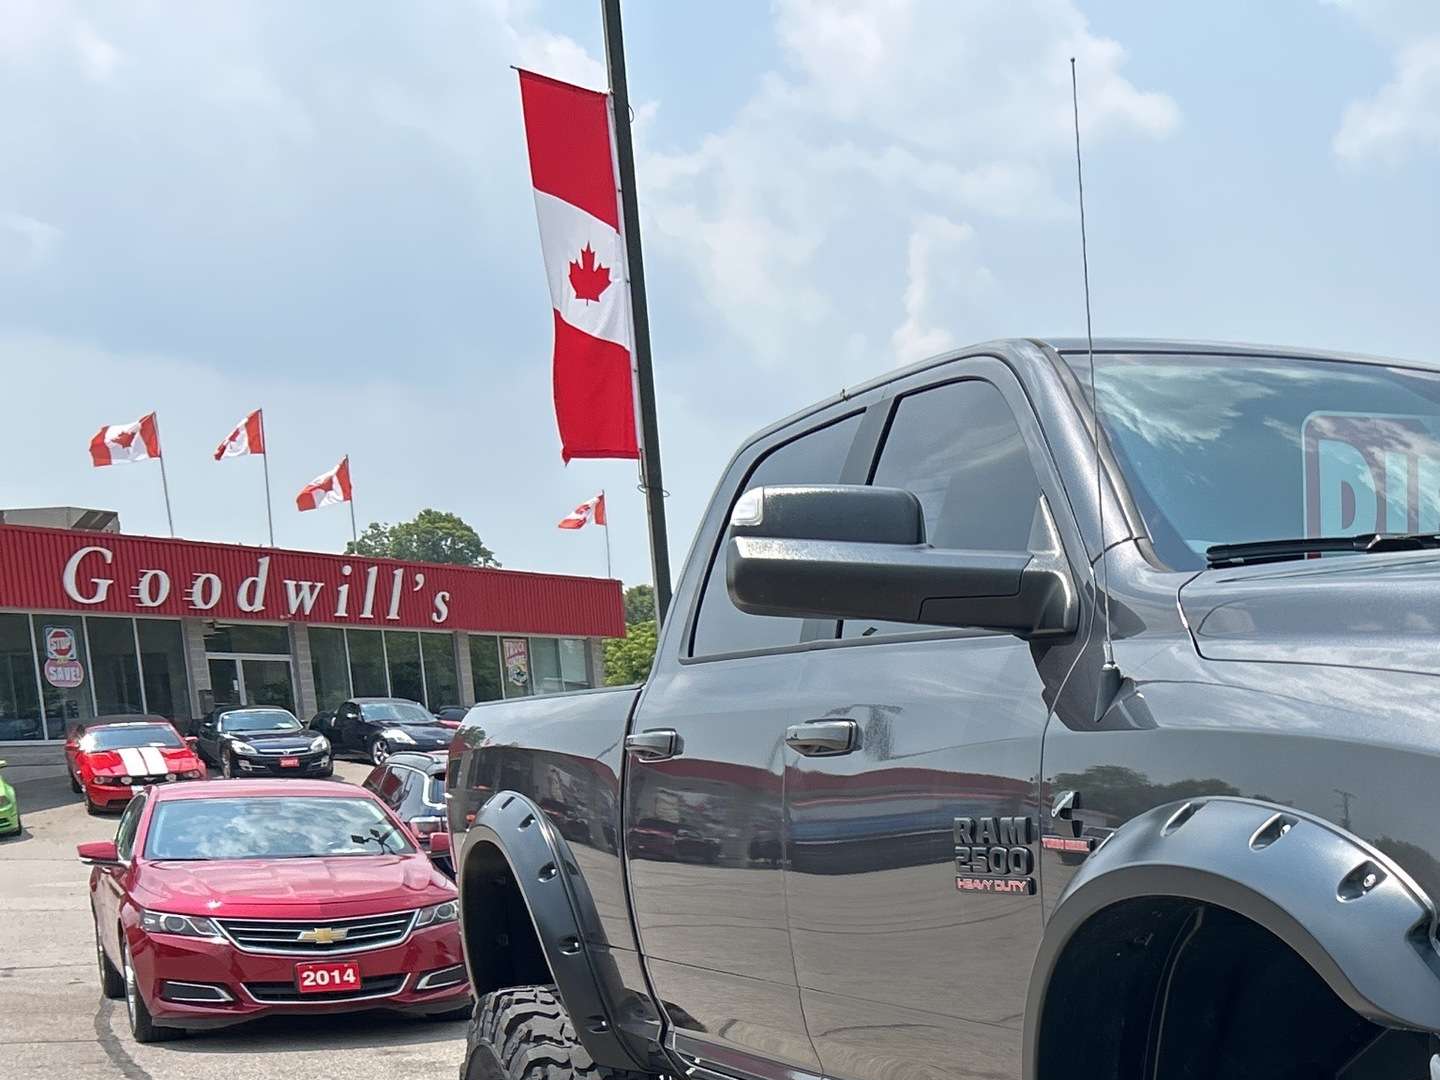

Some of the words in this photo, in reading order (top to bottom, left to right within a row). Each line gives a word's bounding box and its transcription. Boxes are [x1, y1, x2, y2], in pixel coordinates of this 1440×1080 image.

[62, 545, 451, 624] Goodwill's
[48, 666, 81, 681] SAVE!
[954, 816, 1032, 845] RAM
[954, 845, 1034, 875] 2500
[957, 877, 994, 892] HEAVY
[994, 878, 1027, 892] DUTY
[301, 968, 356, 986] 2014
